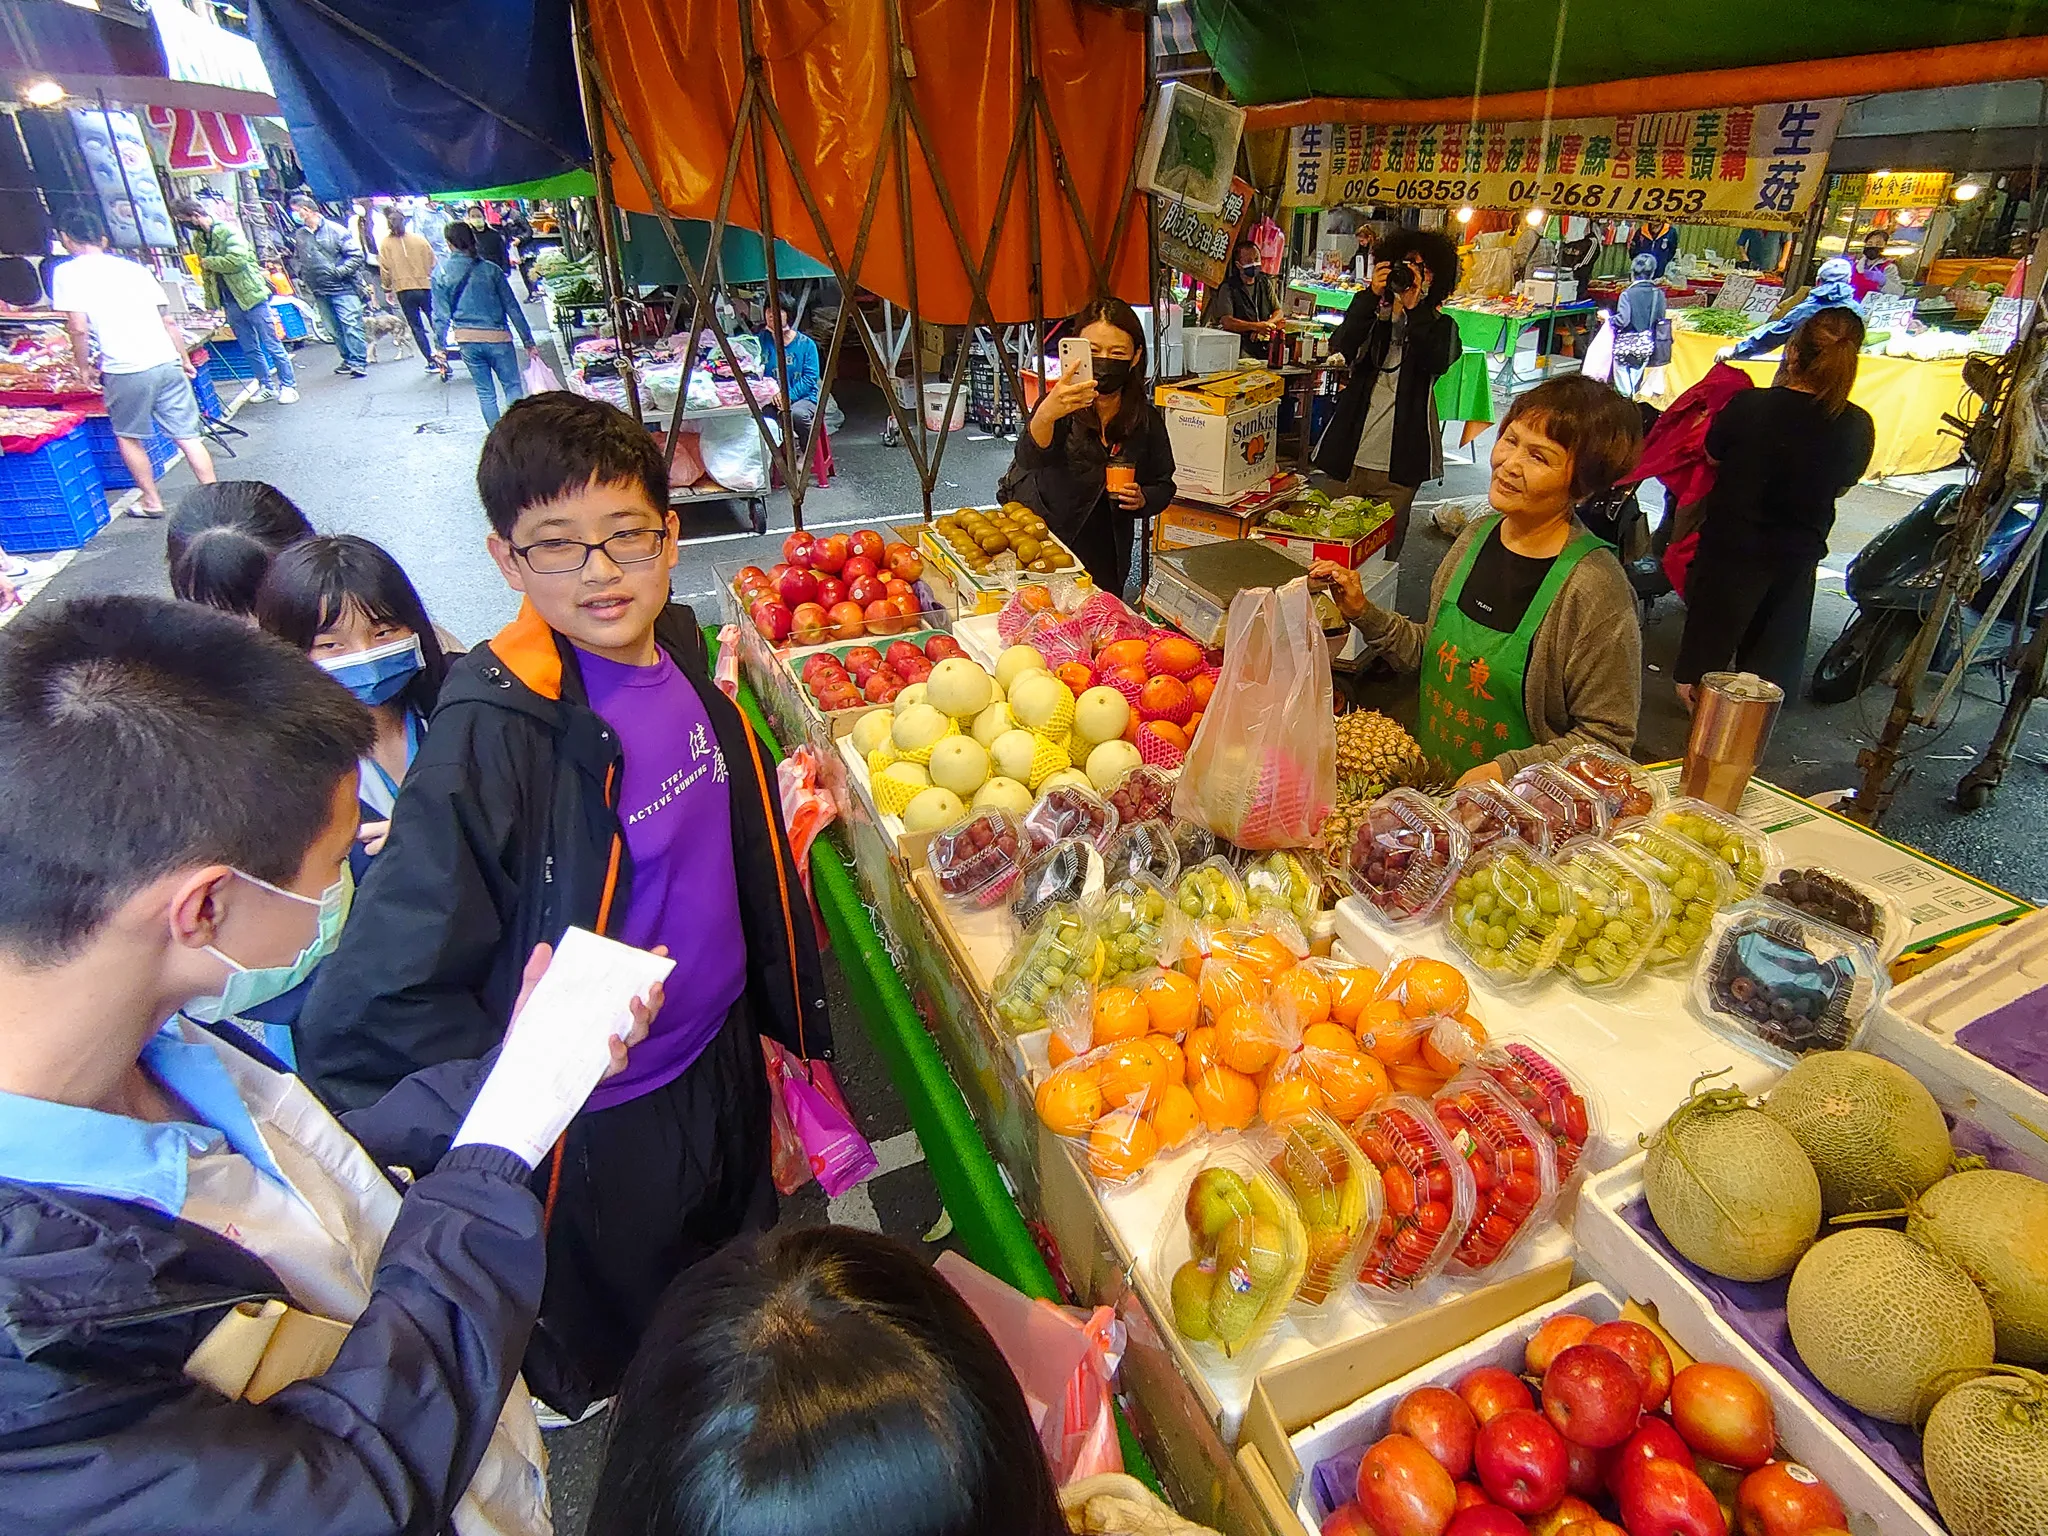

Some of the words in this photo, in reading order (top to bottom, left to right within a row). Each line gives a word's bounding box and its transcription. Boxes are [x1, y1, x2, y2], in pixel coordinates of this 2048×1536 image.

[1296, 124, 1323, 195] 生菇
[1688, 112, 1722, 182] 芋頭
[1718, 108, 1755, 182] 蓮藕
[1754, 102, 1821, 212] 生菇
[1178, 414, 1206, 428] Sunkist
[1232, 408, 1277, 444] Sunkist
[1437, 640, 1495, 701] 竹東
[661, 768, 684, 792] ITRI
[689, 722, 730, 784] 健康
[628, 792, 673, 825] ACTIVE
[674, 763, 708, 795] RUNNING
